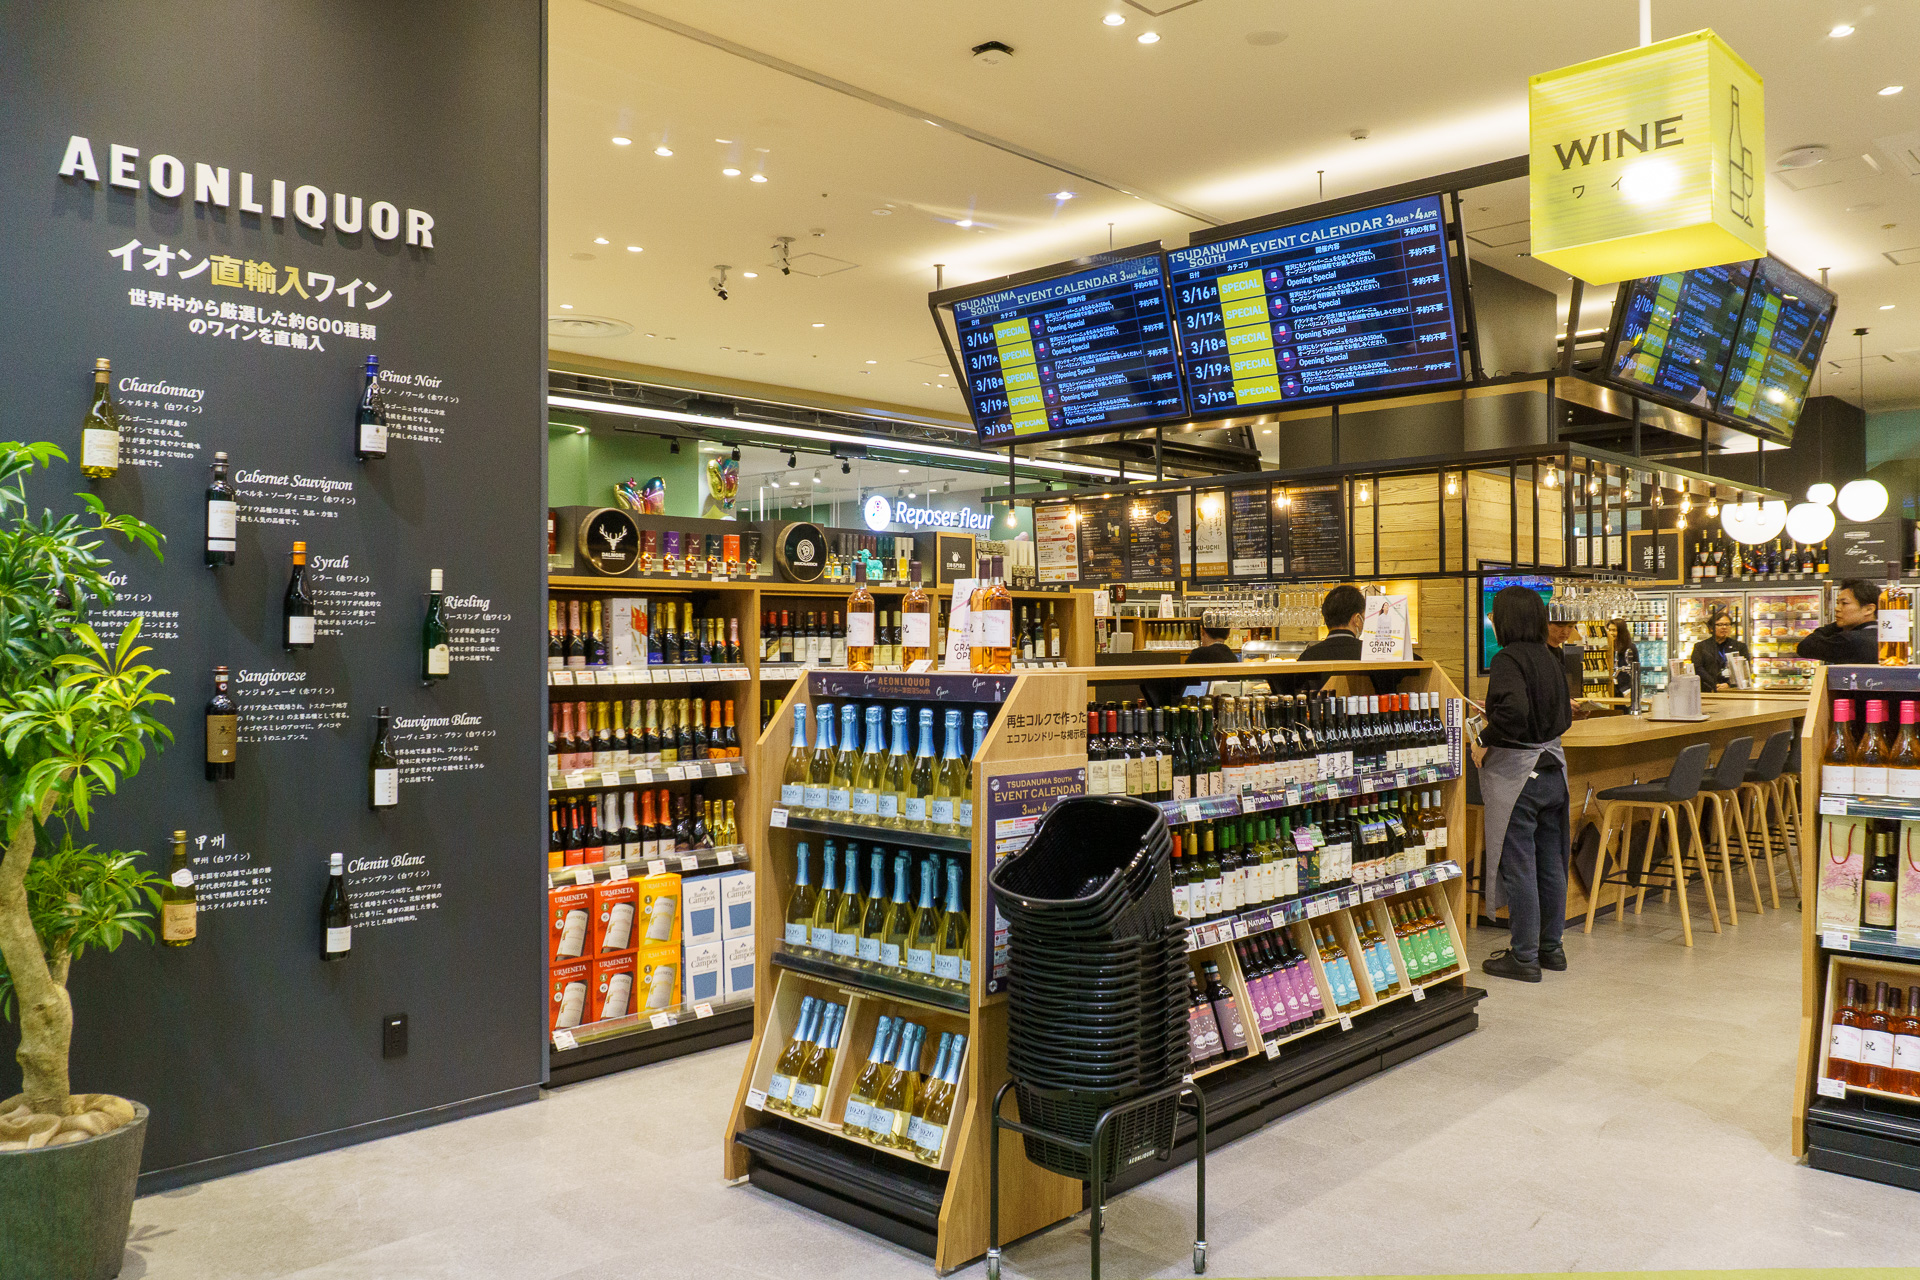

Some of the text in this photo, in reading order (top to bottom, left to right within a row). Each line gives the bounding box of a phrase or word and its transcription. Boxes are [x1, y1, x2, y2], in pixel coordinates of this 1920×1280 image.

[1553, 114, 1684, 170] WINE
[58, 135, 435, 248] AEONLIQUOR
[1250, 235, 1296, 254] EVENT
[1300, 217, 1382, 244] CALENDAR
[1169, 238, 1249, 263] TSUDANUMA
[1408, 245, 1436, 257] 予約不要
[1189, 253, 1226, 268] SOUTH
[1227, 261, 1249, 272] カテゴリ
[108, 239, 393, 310] イオン直輸入ワイン
[1189, 270, 1200, 279] 日付
[1286, 270, 1337, 287] Opening Special
[1412, 273, 1440, 287] 予約不要
[1017, 288, 1052, 304] EVENT
[1055, 275, 1118, 295] CALENDAR
[1222, 279, 1260, 294] SPECIAL
[955, 291, 1016, 311] TSUDANUMA
[1291, 298, 1341, 313] Opening Special
[128, 288, 376, 341] 世界中から厳選した約600種類
[970, 303, 1000, 316] SOUTH
[1226, 305, 1264, 320] SPECIAL
[1416, 303, 1444, 315] 予約不要
[997, 326, 1027, 339] SPECIAL
[1047, 319, 1085, 333] Opening Special
[1295, 325, 1347, 340] Opening Special
[189, 317, 325, 352] のワインを直輸入
[1230, 331, 1268, 346] SPECIAL
[1419, 331, 1447, 343] 予約不要
[1001, 348, 1032, 362] SPECIAL
[1299, 353, 1349, 367] Opening Special
[1234, 357, 1273, 372] SPECIAL
[380, 370, 442, 389] Pinot Noir
[1006, 372, 1036, 384] SPECIAL
[1056, 366, 1096, 380] Opening Special
[118, 376, 204, 402] Chardonnay
[1238, 385, 1277, 397] SPECIAL
[1303, 380, 1355, 393] Opening Special
[1010, 394, 1041, 406] SPECIAL
[1015, 418, 1046, 429] SPECIAL
[235, 469, 353, 493] Cabernet Sauvignon
[896, 501, 995, 530] Reposer fleur
[310, 555, 349, 571] Syrah
[444, 595, 490, 611] Riesling
[235, 668, 307, 686] Sangiovese
[878, 676, 931, 687] AEONLIQUOR
[392, 712, 482, 731] Sauvignon Blanc
[1006, 711, 1087, 729] 再生コルクで作った
[1006, 728, 1087, 745] エコフレンドリーな掲示板
[1006, 778, 1052, 789] TSUDANUMA
[995, 783, 1082, 802] EVENT CALENDAR
[195, 833, 225, 850] 甲州
[347, 853, 426, 874] Chenin Blanc
[554, 893, 588, 903] URMENETA
[600, 887, 634, 897] URMENETA
[1248, 915, 1271, 927] NATURAL
[599, 957, 632, 968] URMENETA
[553, 965, 586, 976] URMENETA
